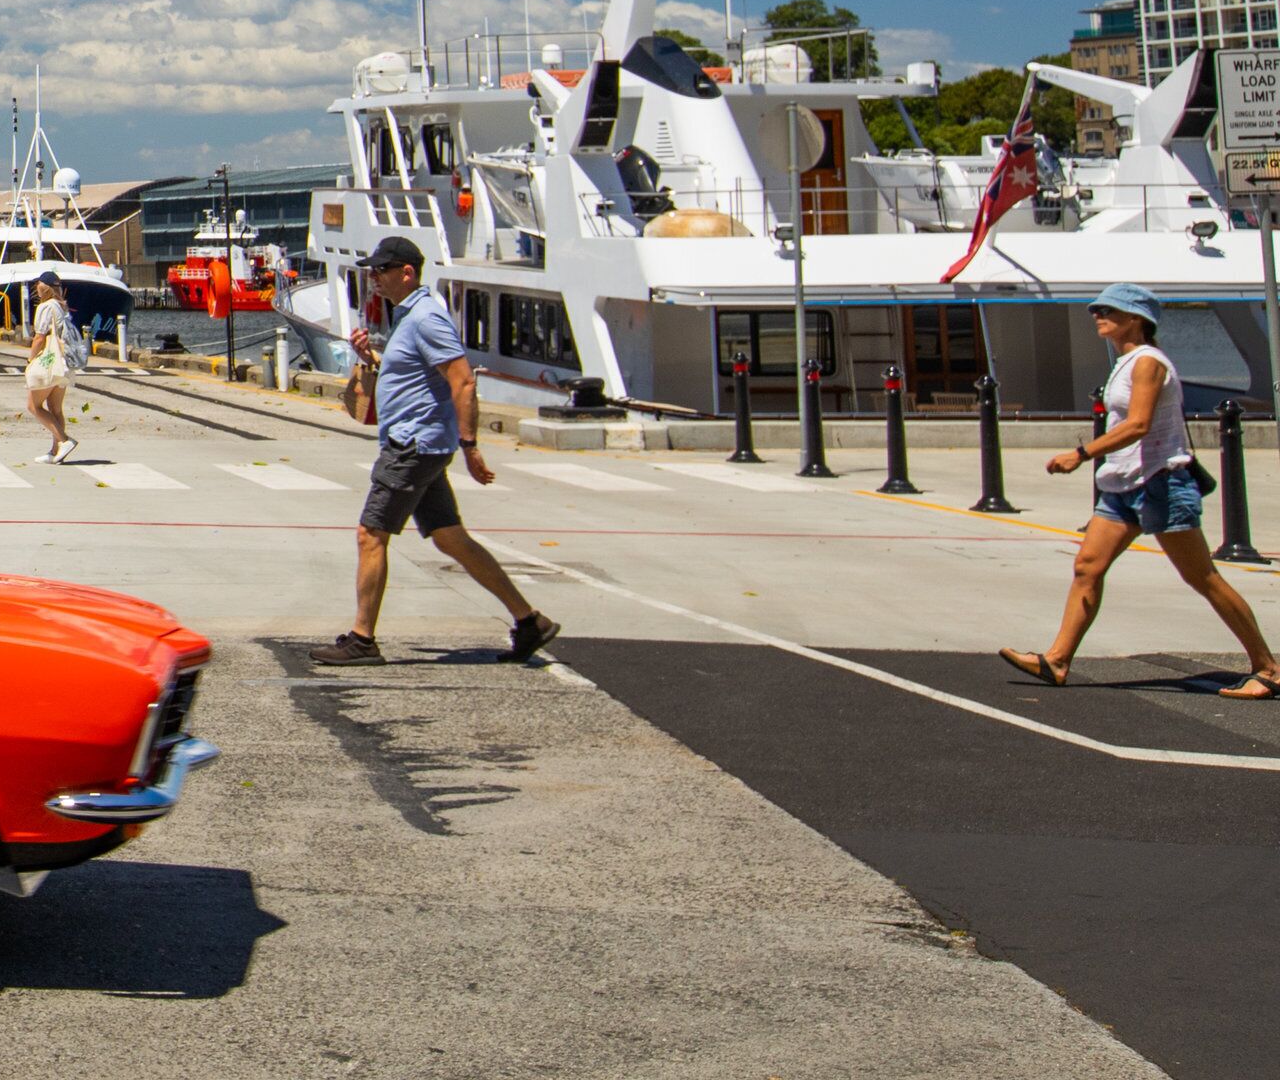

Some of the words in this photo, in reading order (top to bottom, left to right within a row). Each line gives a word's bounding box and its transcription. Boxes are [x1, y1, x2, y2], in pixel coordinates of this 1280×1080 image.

[1234, 60, 1280, 71] WHARF
[1241, 75, 1276, 87] LOAD
[1243, 91, 1276, 103] LIMIT
